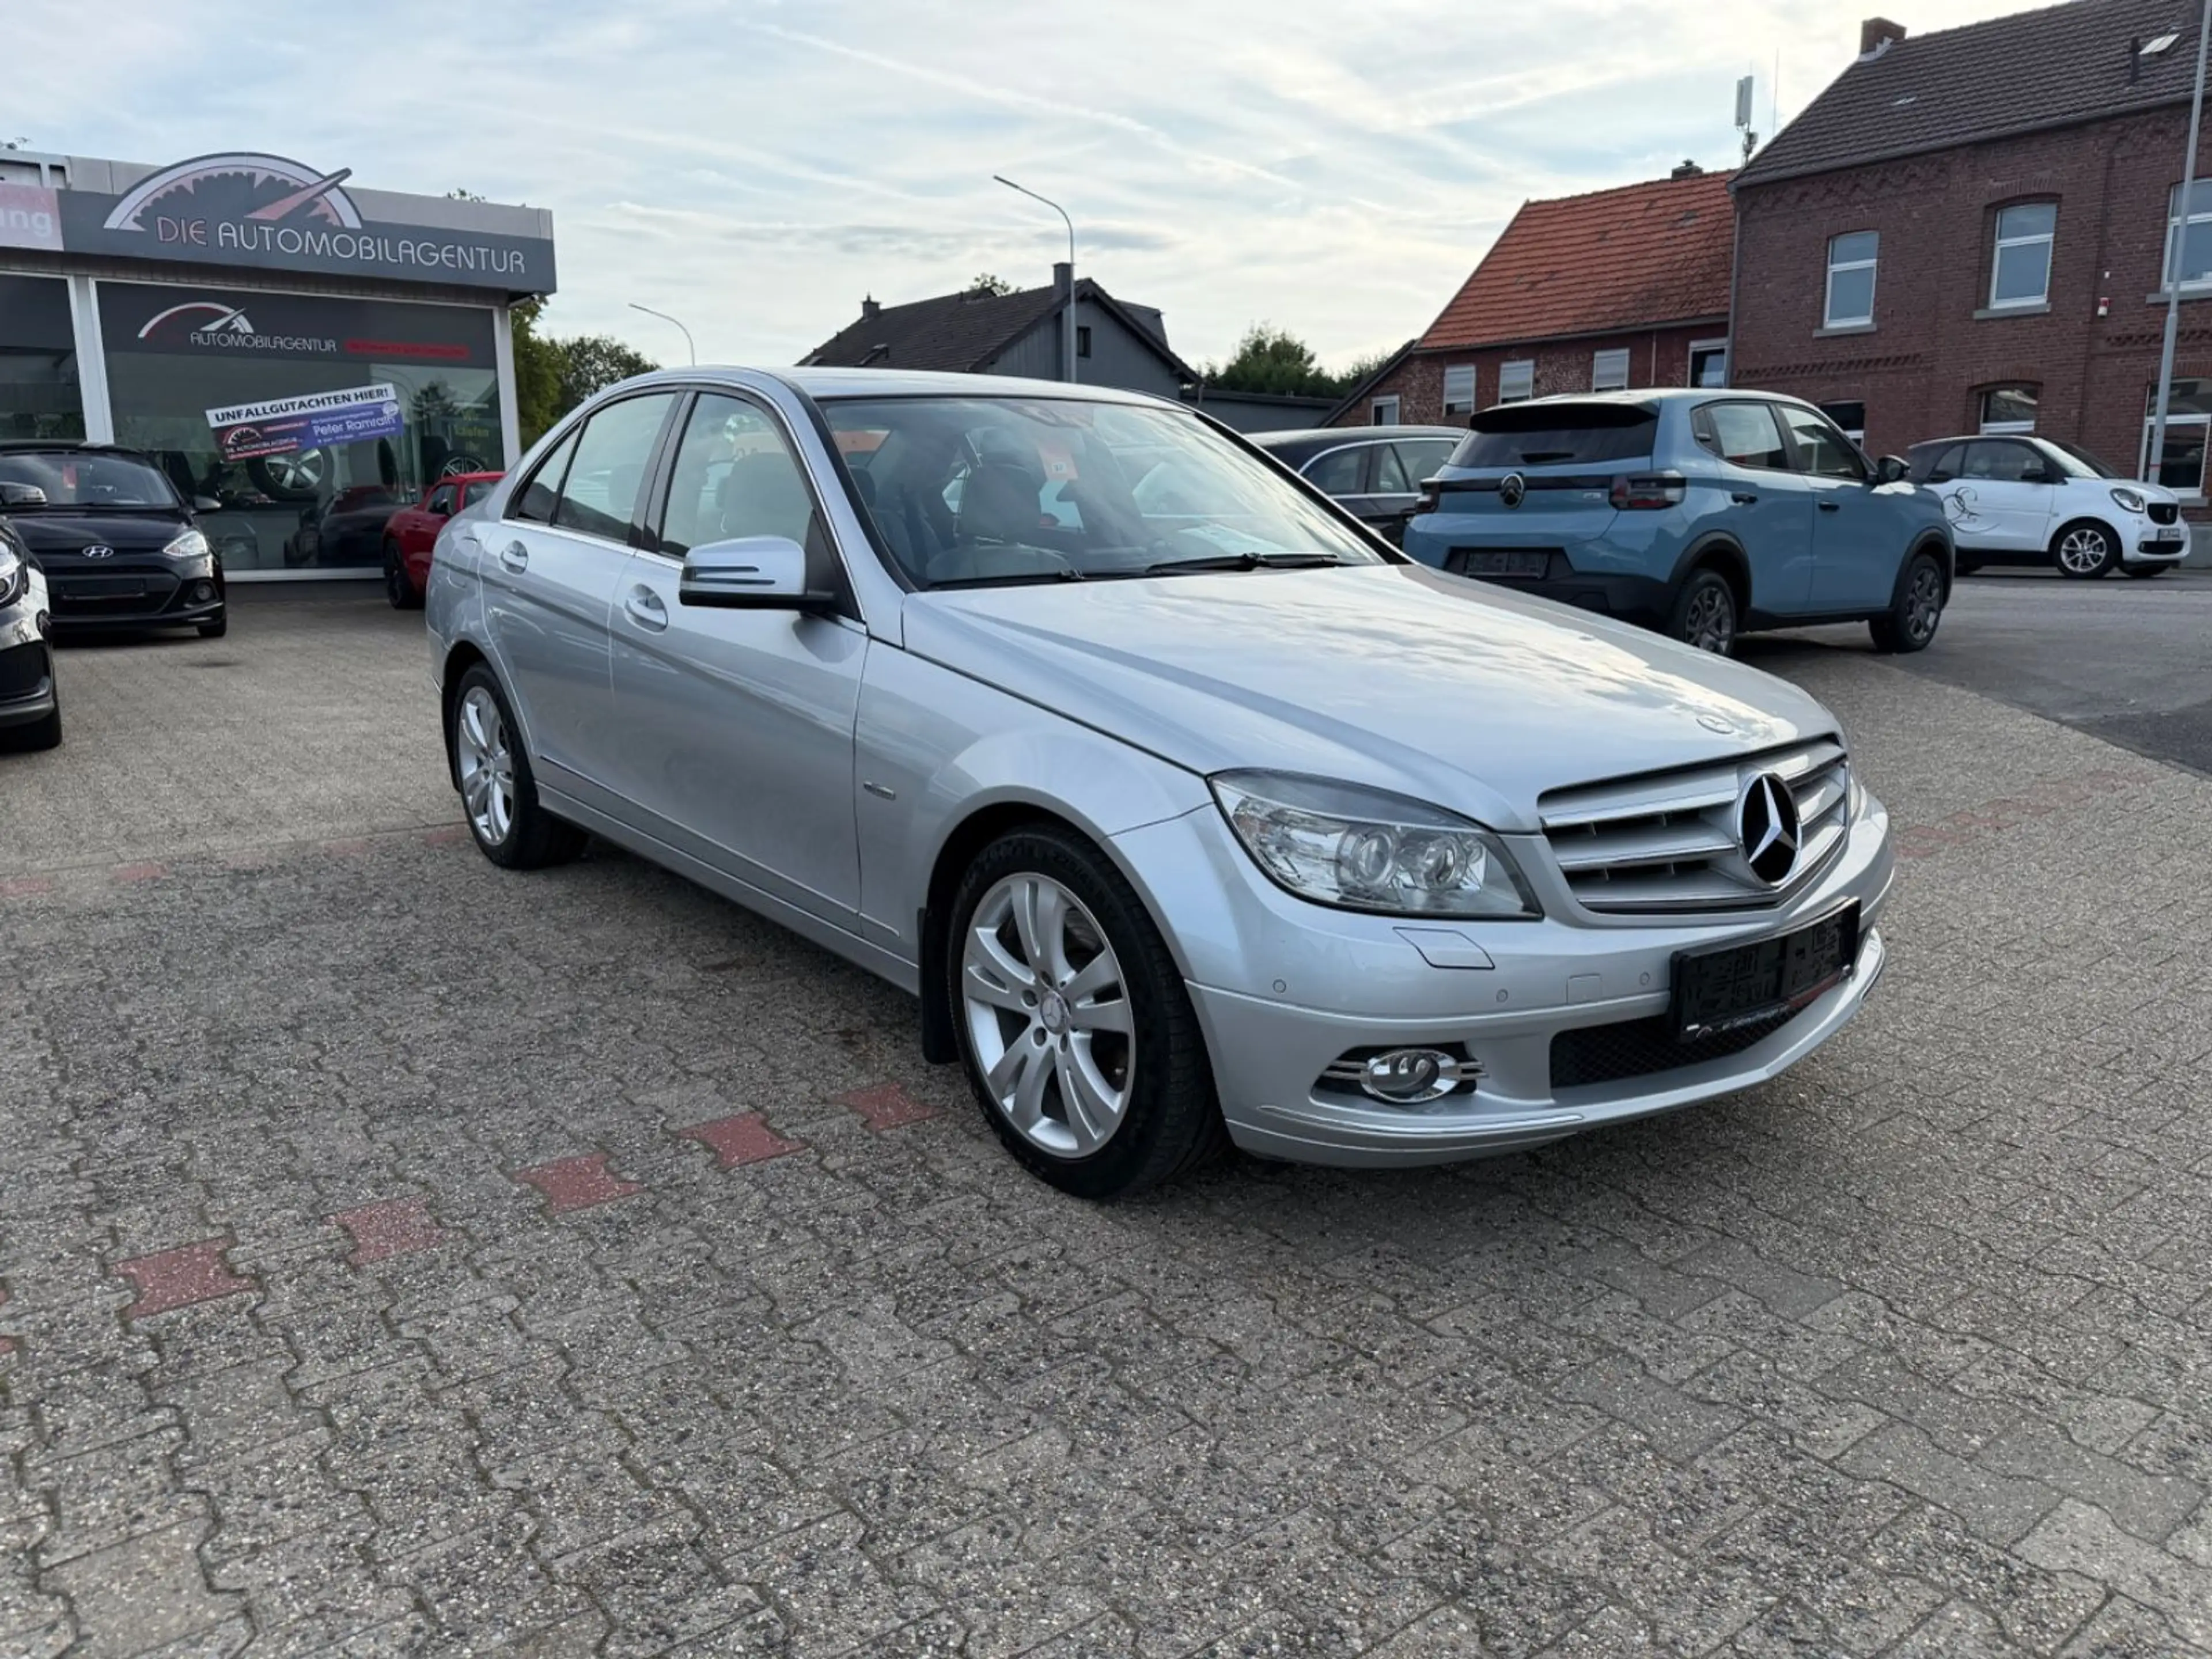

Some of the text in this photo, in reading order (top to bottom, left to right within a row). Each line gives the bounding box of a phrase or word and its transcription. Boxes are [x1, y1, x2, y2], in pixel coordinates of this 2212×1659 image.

[156, 216, 525, 274] DIE AUTOMOBILAGENTUR
[190, 332, 337, 352] AUTOMOBILAGENTUR
[215, 390, 351, 422] UNFALLGUTACHTEN
[354, 387, 388, 402] HIER!
